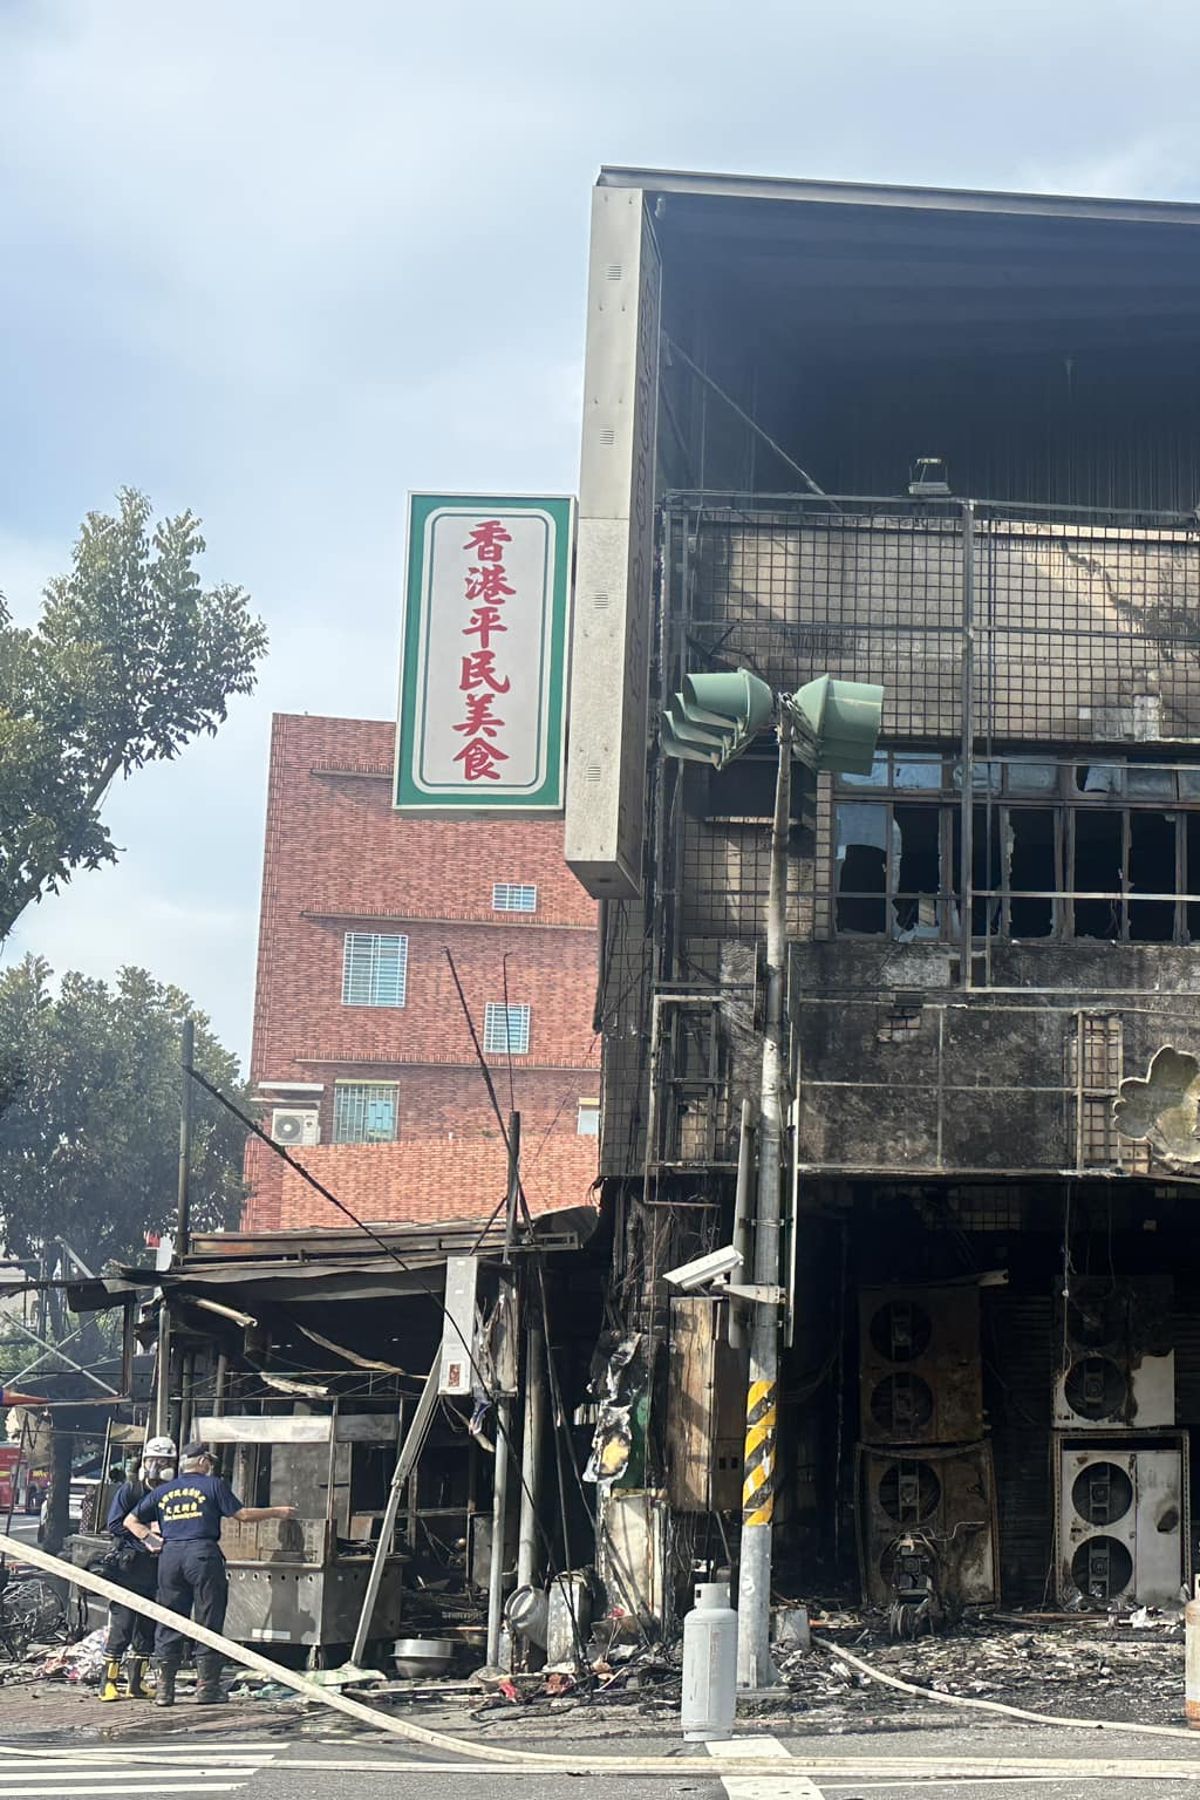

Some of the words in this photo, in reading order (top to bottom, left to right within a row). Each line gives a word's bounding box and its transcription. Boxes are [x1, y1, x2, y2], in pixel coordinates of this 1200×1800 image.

[452, 520, 516, 781] 香港平民美食
